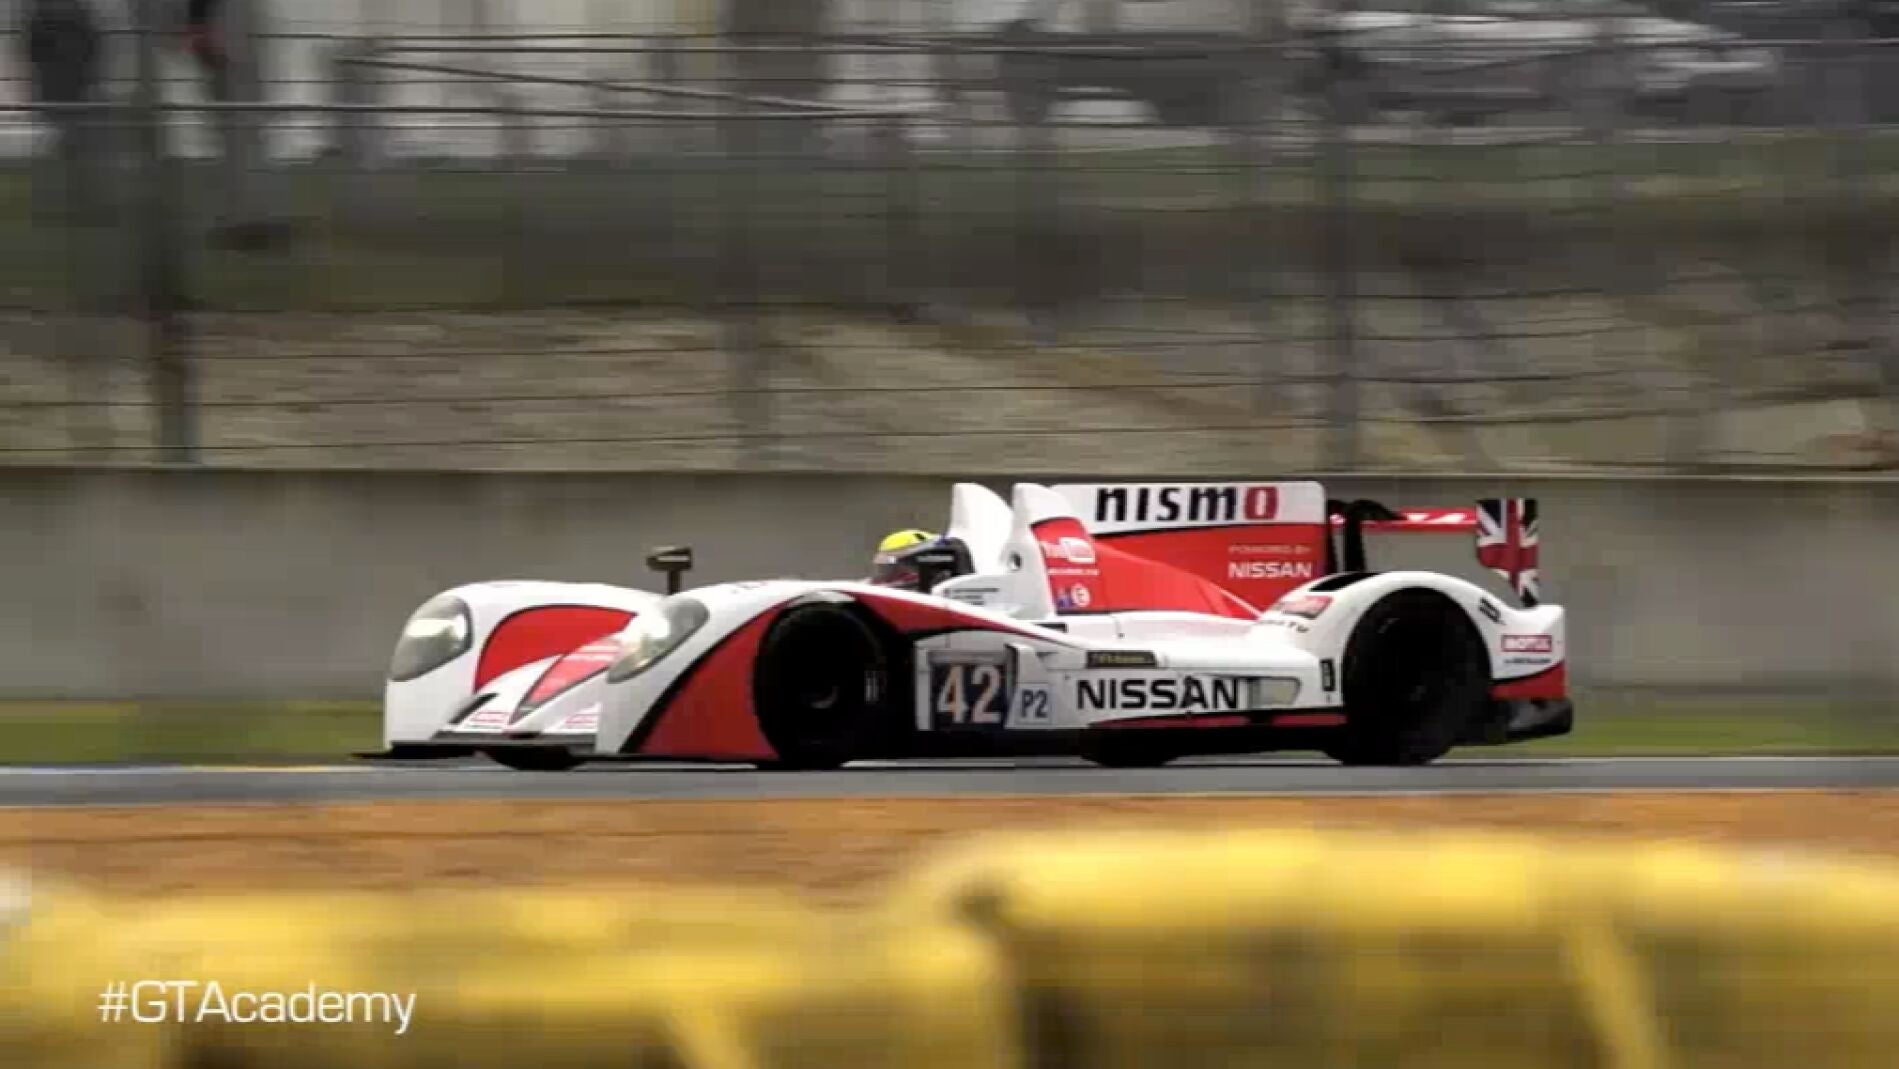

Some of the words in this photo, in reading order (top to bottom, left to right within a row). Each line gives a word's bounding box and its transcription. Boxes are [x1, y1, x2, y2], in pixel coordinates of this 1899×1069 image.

[1228, 561, 1312, 578] NISSAN
[937, 665, 1001, 724] 42
[1021, 689, 1048, 719] P2
[1077, 677, 1239, 709] NISSAN
